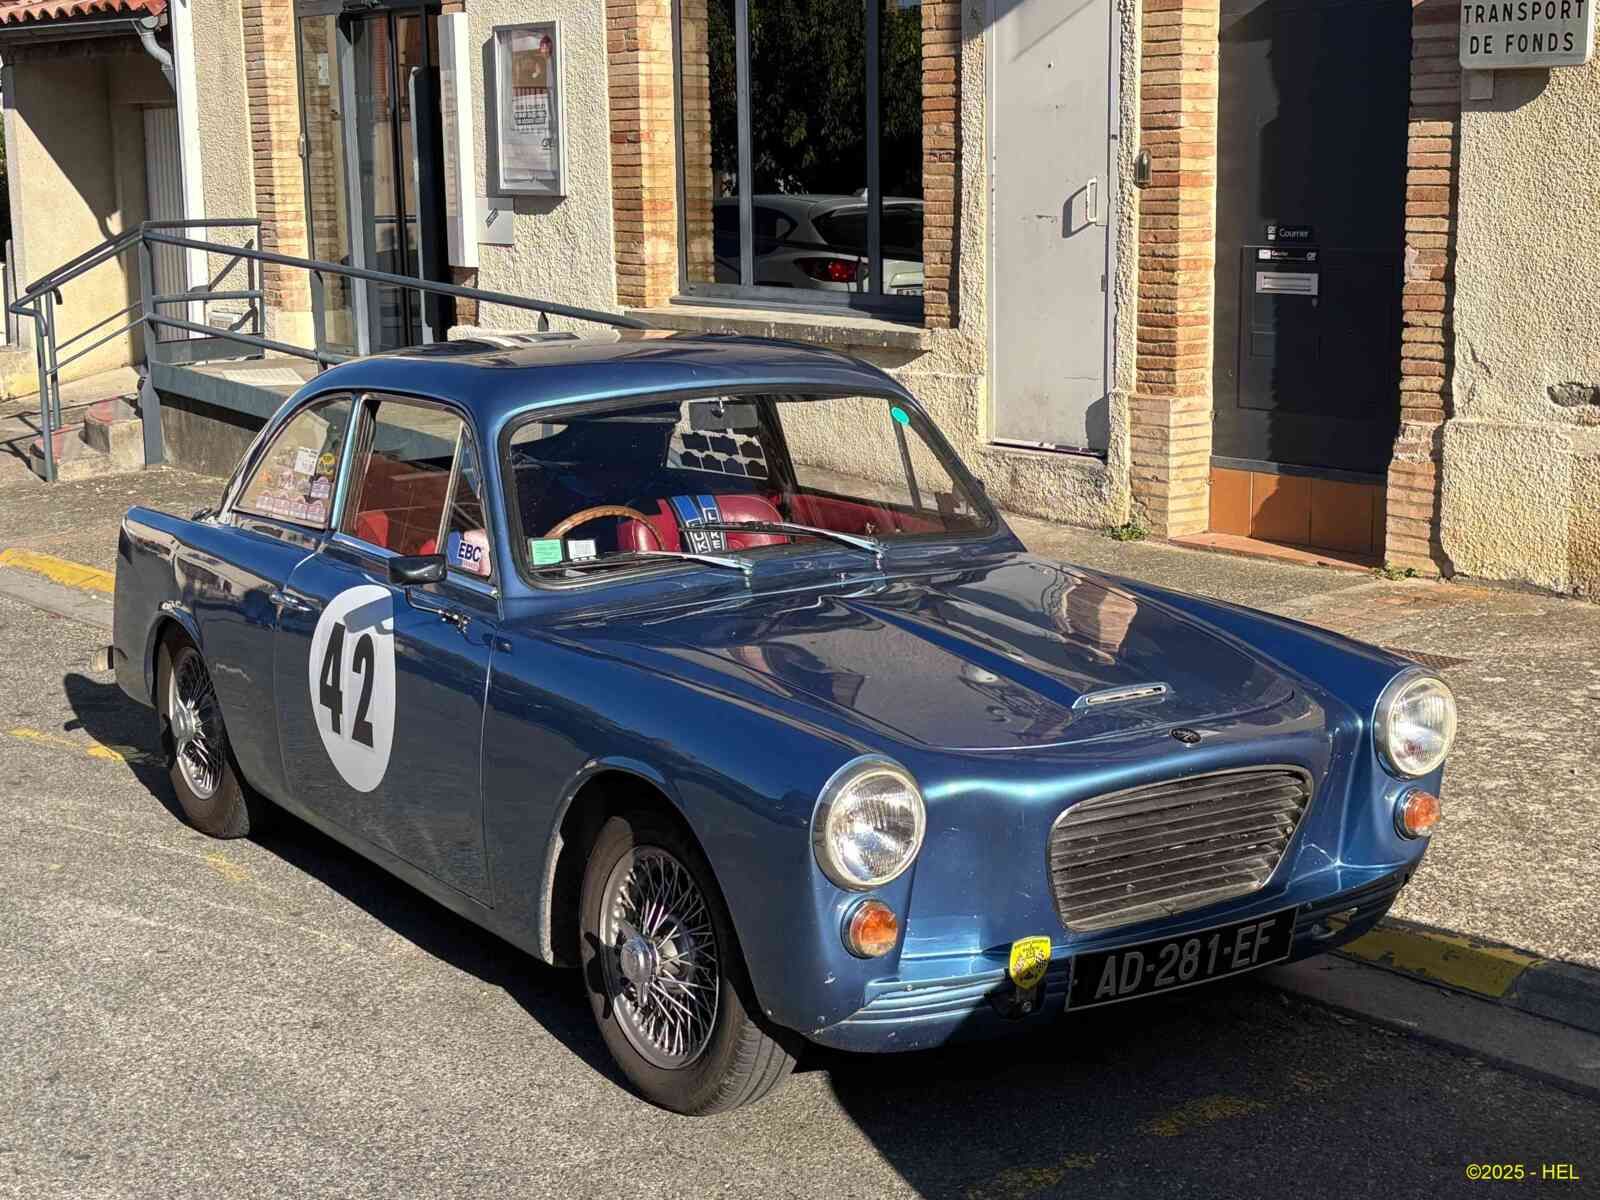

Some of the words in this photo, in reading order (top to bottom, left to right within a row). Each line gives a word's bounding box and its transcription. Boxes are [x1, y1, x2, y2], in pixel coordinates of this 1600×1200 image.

[1463, 0, 1585, 24] TRANSPORT
[1470, 35, 1493, 55] DE
[1505, 32, 1574, 53] FONDS
[458, 542, 482, 562] EBC
[319, 622, 375, 749] 42
[1094, 919, 1276, 1000] AD-281-EF
